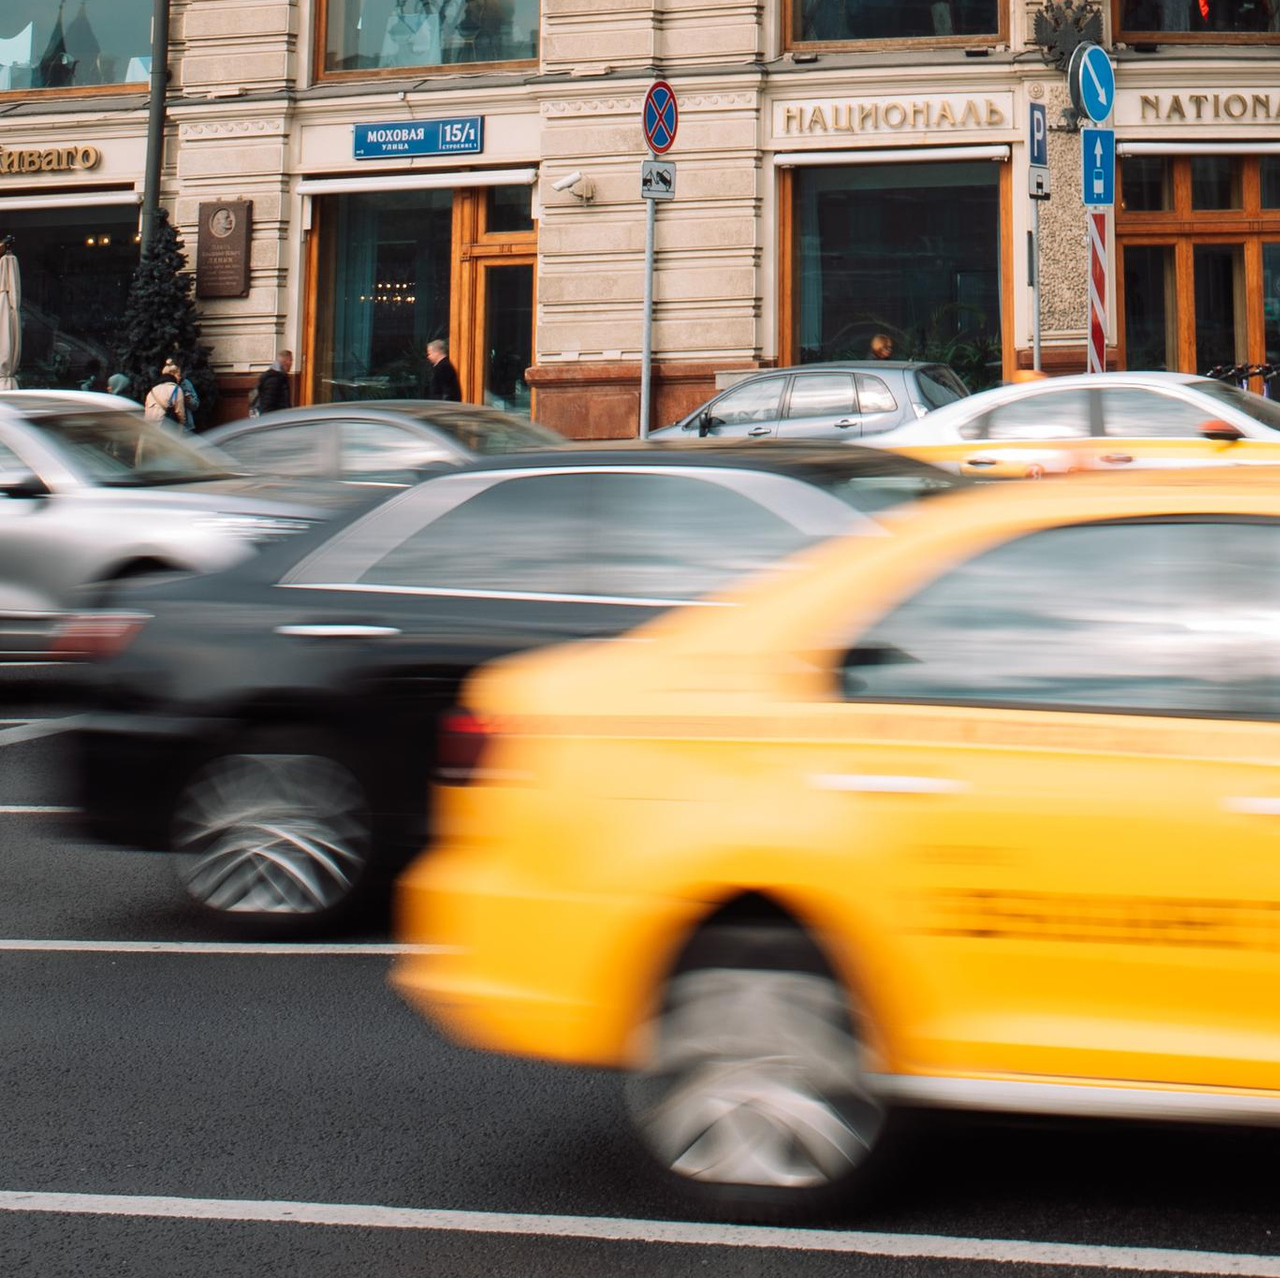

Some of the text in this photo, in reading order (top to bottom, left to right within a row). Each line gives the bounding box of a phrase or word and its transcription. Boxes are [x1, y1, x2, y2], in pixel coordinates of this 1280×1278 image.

[784, 99, 1004, 132] НАЦИОНАЛЬ
[367, 128, 425, 143] МОХОВАЯ
[444, 123, 475, 142] 15/1
[381, 143, 409, 151] УЛИЦА
[0, 145, 99, 174] иваго
